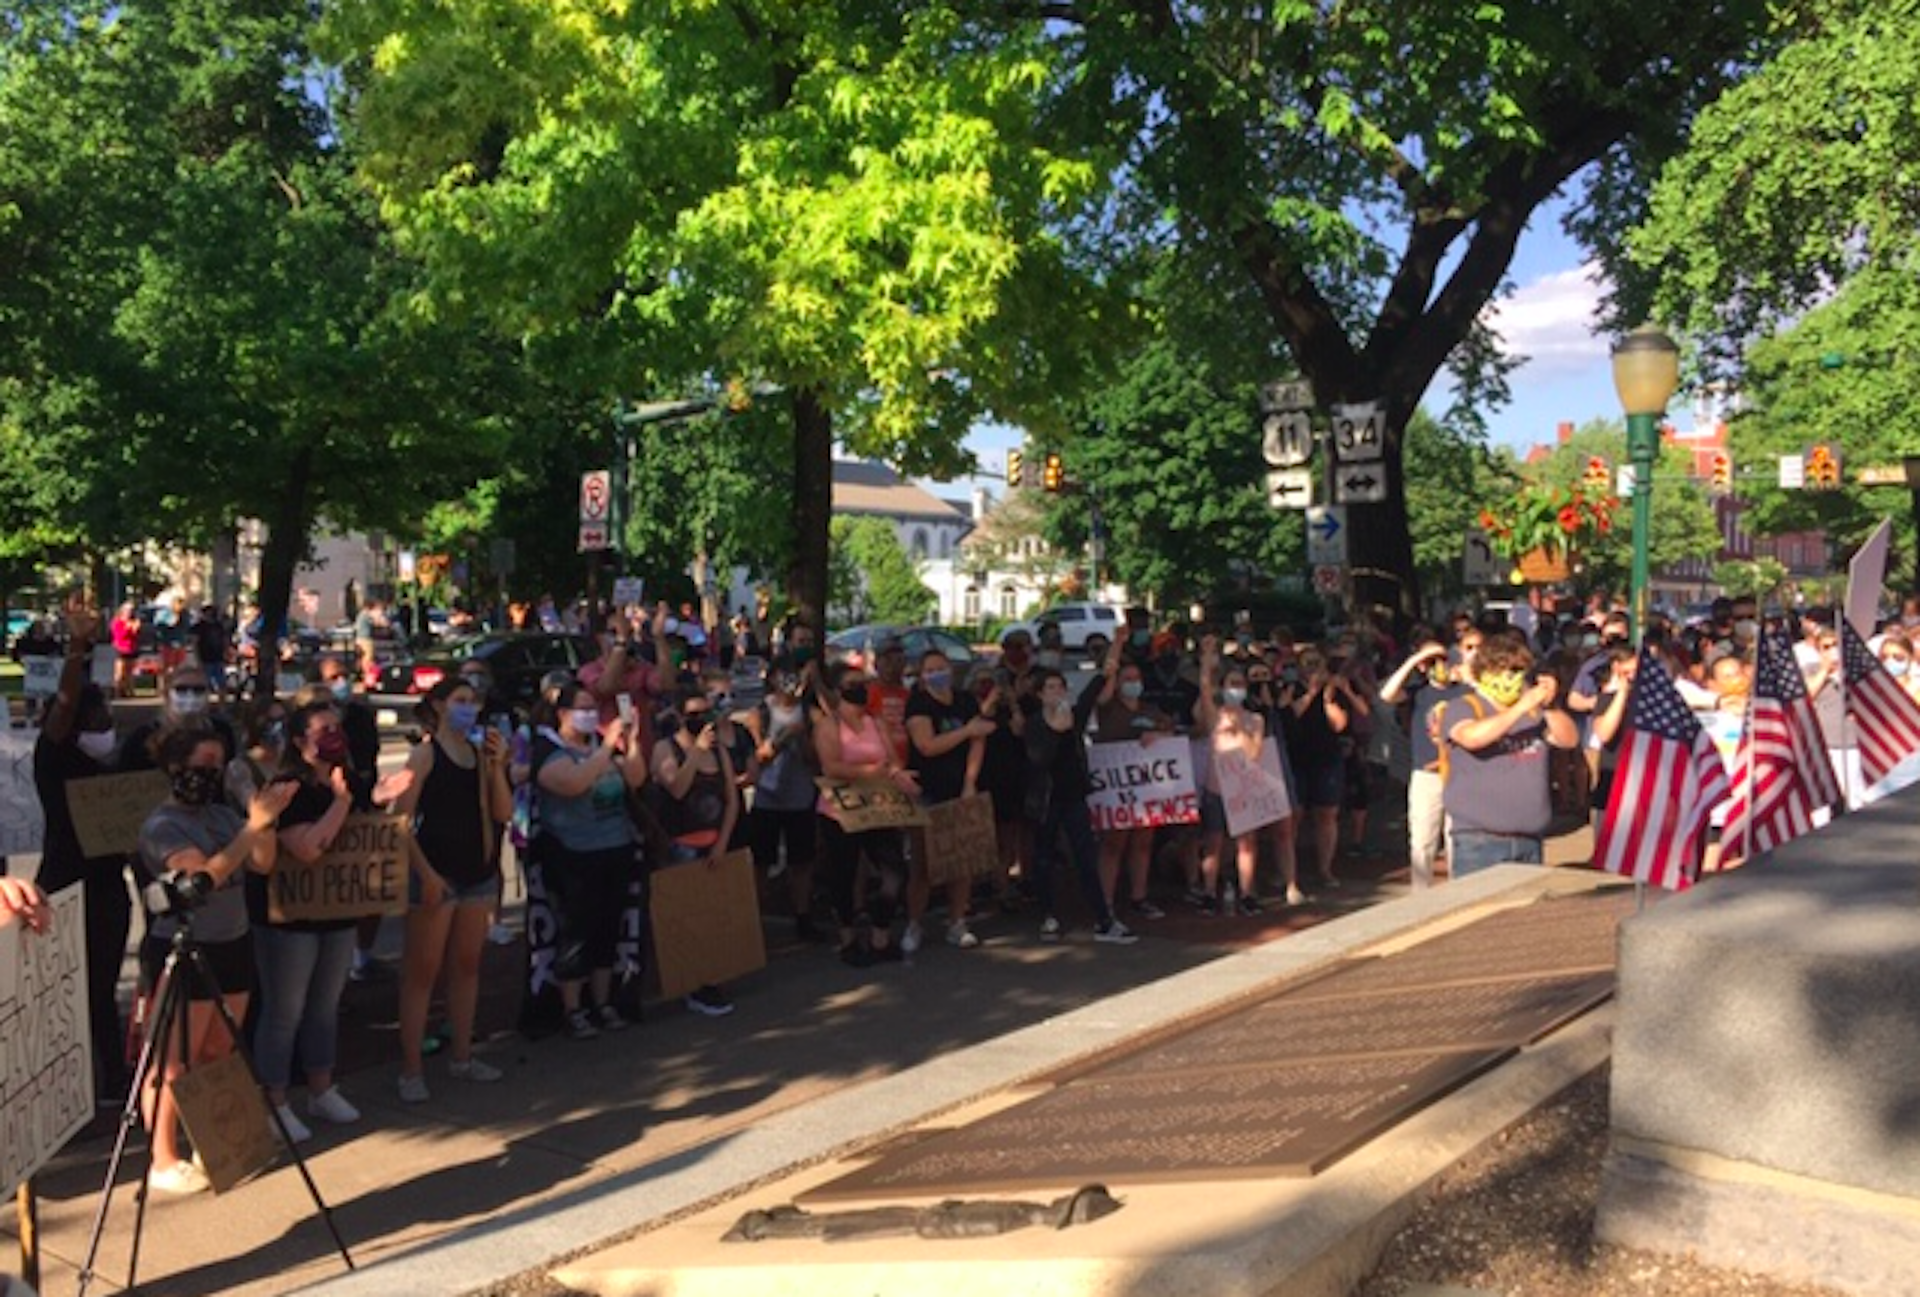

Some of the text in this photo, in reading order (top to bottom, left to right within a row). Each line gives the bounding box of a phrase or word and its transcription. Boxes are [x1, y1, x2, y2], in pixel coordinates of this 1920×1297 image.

[1277, 423, 1298, 452] 11
[1339, 417, 1378, 450] 34
[1088, 759, 1182, 793] SILENCE
[1088, 793, 1200, 828] VIOLENCE
[324, 822, 400, 853] USTICE
[278, 859, 398, 906] NO PEACE
